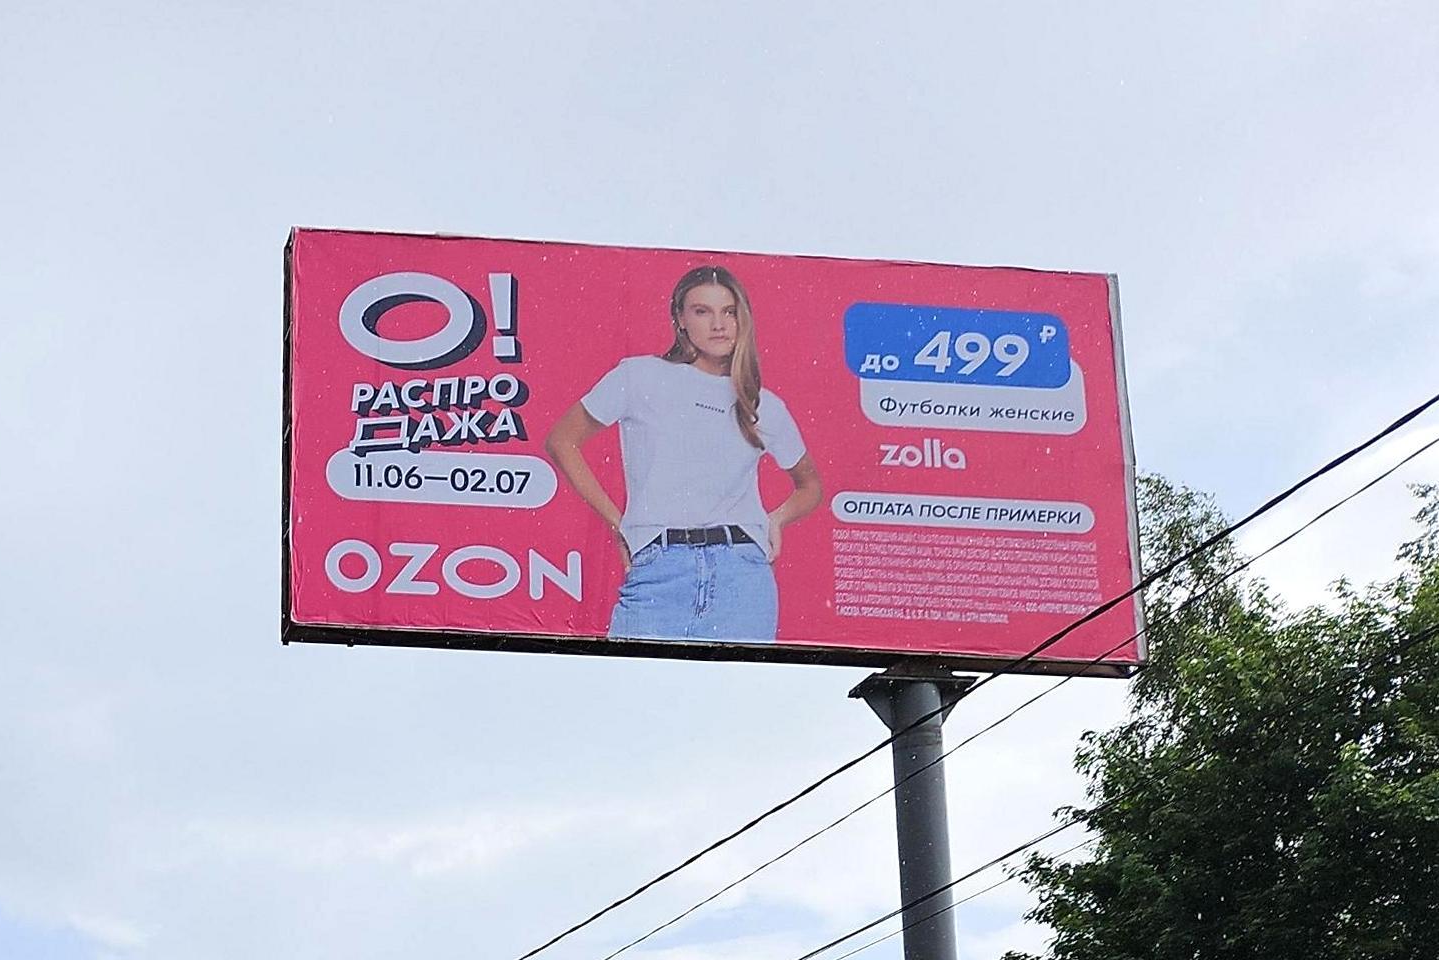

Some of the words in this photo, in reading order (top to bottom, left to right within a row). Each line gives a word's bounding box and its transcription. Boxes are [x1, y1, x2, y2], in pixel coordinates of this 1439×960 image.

[339, 271, 521, 370] О!
[860, 353, 900, 373] до
[913, 330, 1030, 377] 499
[351, 372, 527, 414] РАСПРО
[879, 397, 981, 418] Футболки
[989, 406, 1075, 423] женские
[348, 408, 526, 455] ДАЖА
[880, 438, 967, 470] zolla
[843, 500, 915, 518] ОПЛАТА
[919, 504, 981, 520] ПОСЛЕ
[986, 507, 1081, 525] ПРИМЕРКИ
[325, 539, 583, 602] OZON
